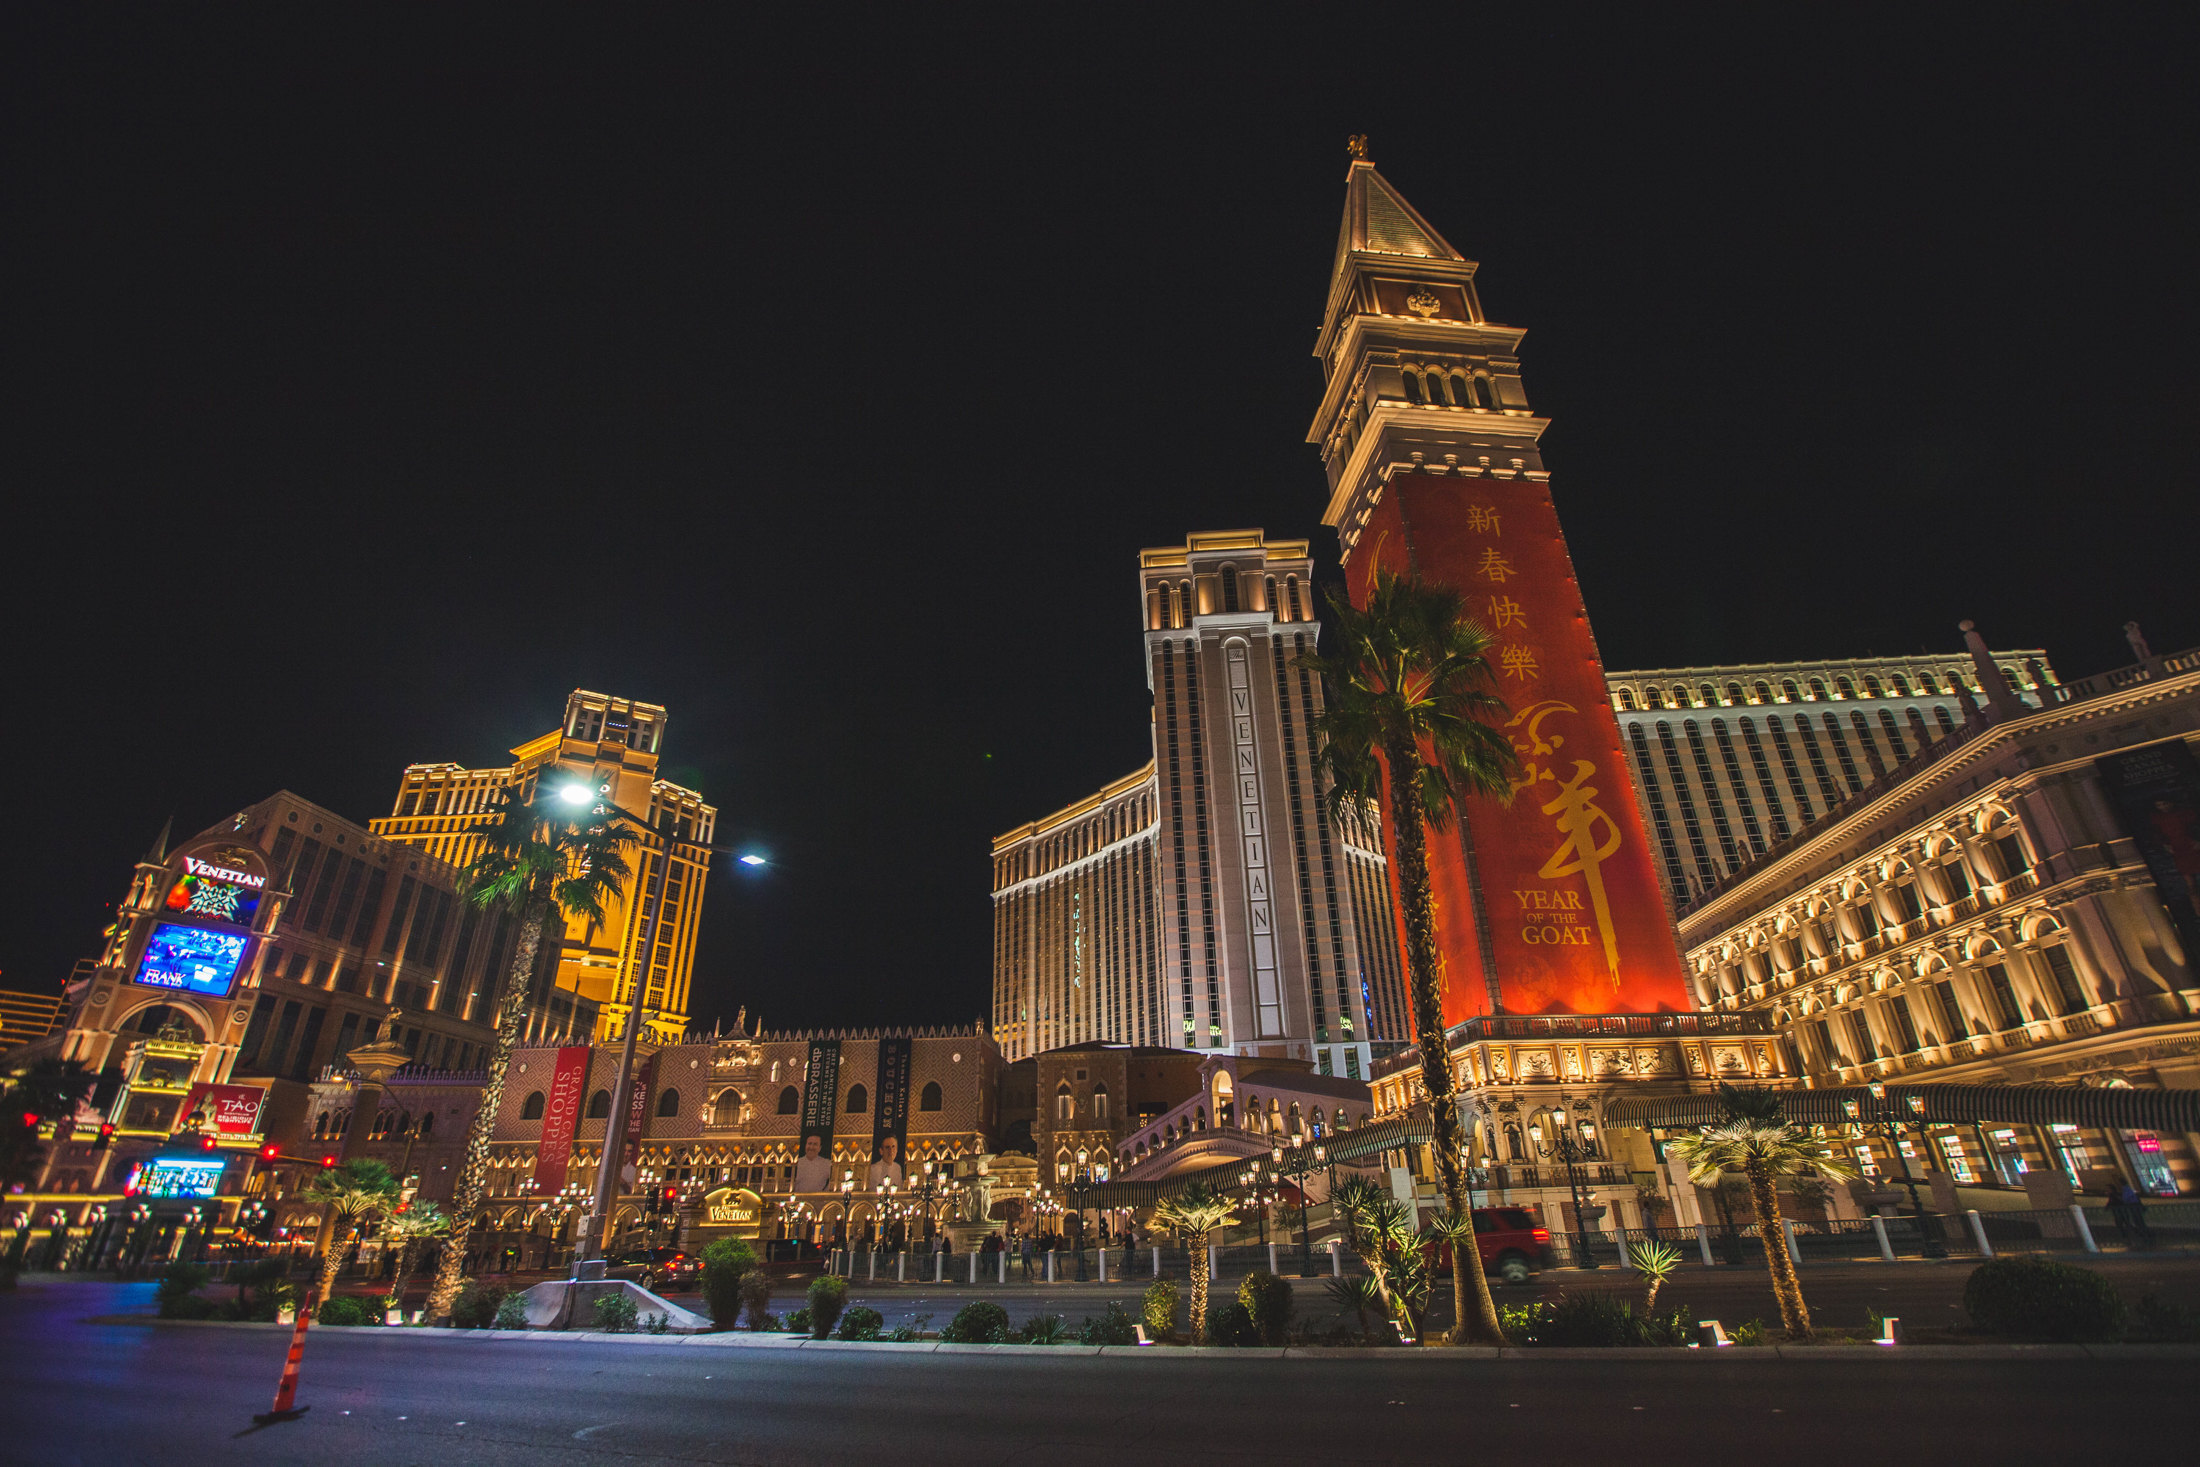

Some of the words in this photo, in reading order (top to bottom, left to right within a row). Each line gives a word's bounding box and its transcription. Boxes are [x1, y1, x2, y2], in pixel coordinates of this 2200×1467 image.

[1466, 504, 1540, 682] 新春快樂
[1234, 692, 1267, 928] VENETIAN
[184, 856, 266, 888] VENETIAN
[189, 879, 245, 909] ROCK
[1512, 889, 1585, 910] YEAR
[1526, 912, 1544, 924] OF
[1549, 912, 1578, 924] THE
[1521, 925, 1592, 945] GOAT
[565, 1066, 582, 1116] GRAND
[882, 1044, 897, 1128] BOUCHON
[221, 1099, 259, 1113] TAO
[541, 1072, 571, 1164] SHOPPES
[554, 1120, 573, 1170] CANAL
[709, 1206, 753, 1222] VENETIAN
